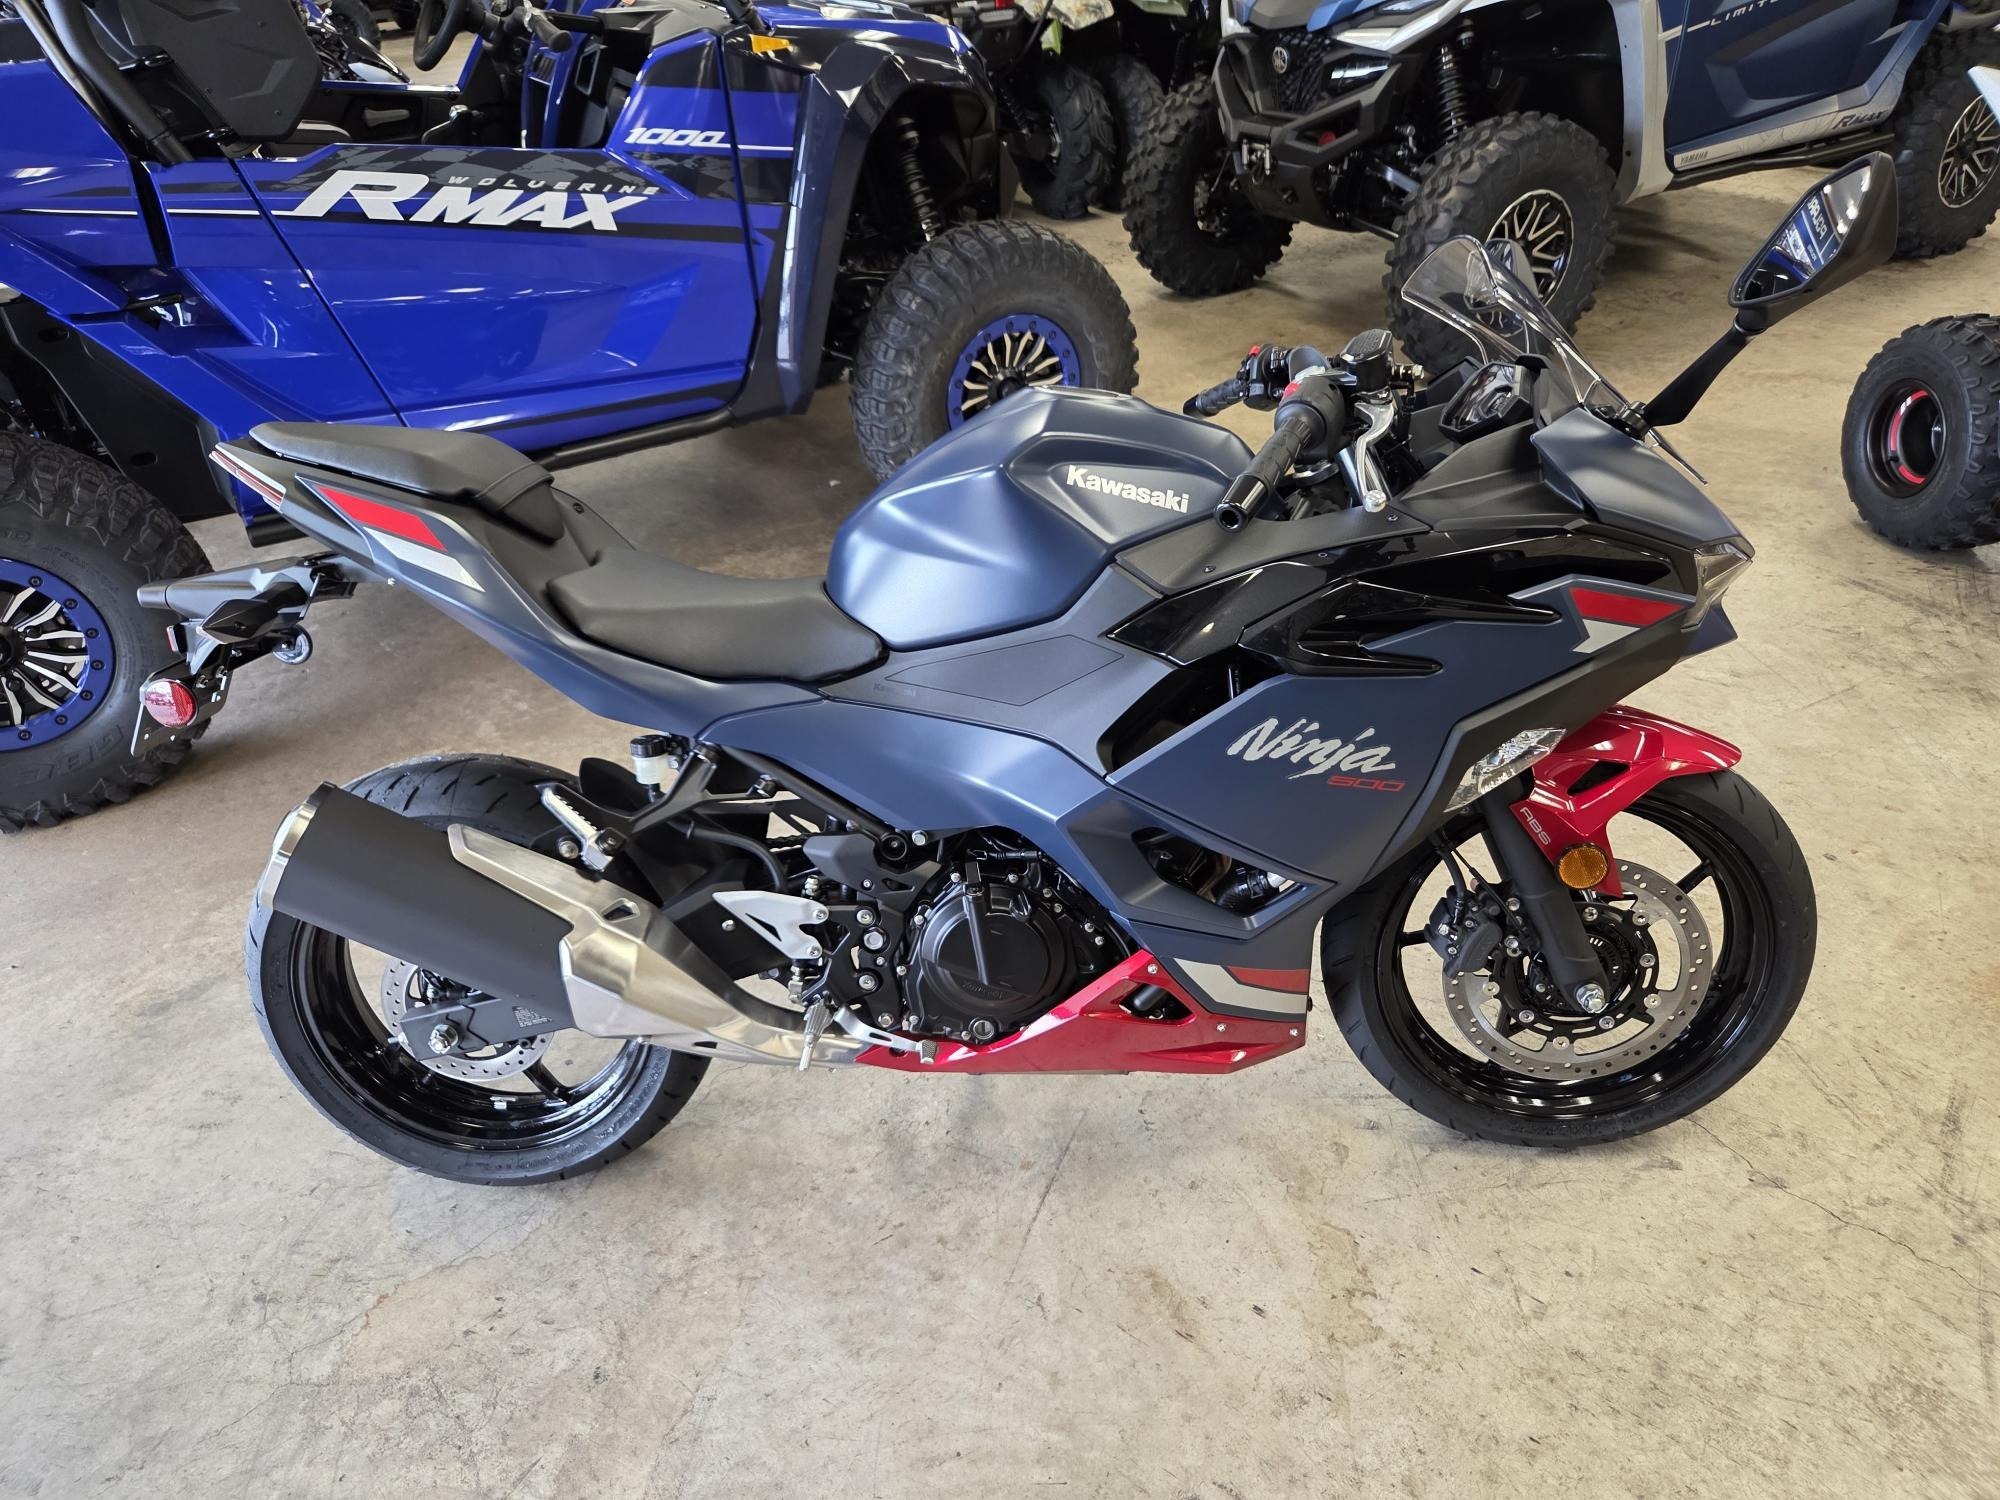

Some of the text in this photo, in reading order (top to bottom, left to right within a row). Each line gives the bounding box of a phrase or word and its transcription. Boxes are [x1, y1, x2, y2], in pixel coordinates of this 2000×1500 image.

[1710, 0, 1779, 26] LIMIT
[624, 127, 727, 148] 1000
[290, 169, 649, 231] RMAX
[448, 176, 660, 195] WOLVERINE
[1066, 464, 1190, 513] Kawasaki
[1226, 717, 1396, 780] Ninja
[1327, 775, 1406, 792] 500
[1519, 806, 1551, 845] ABS
